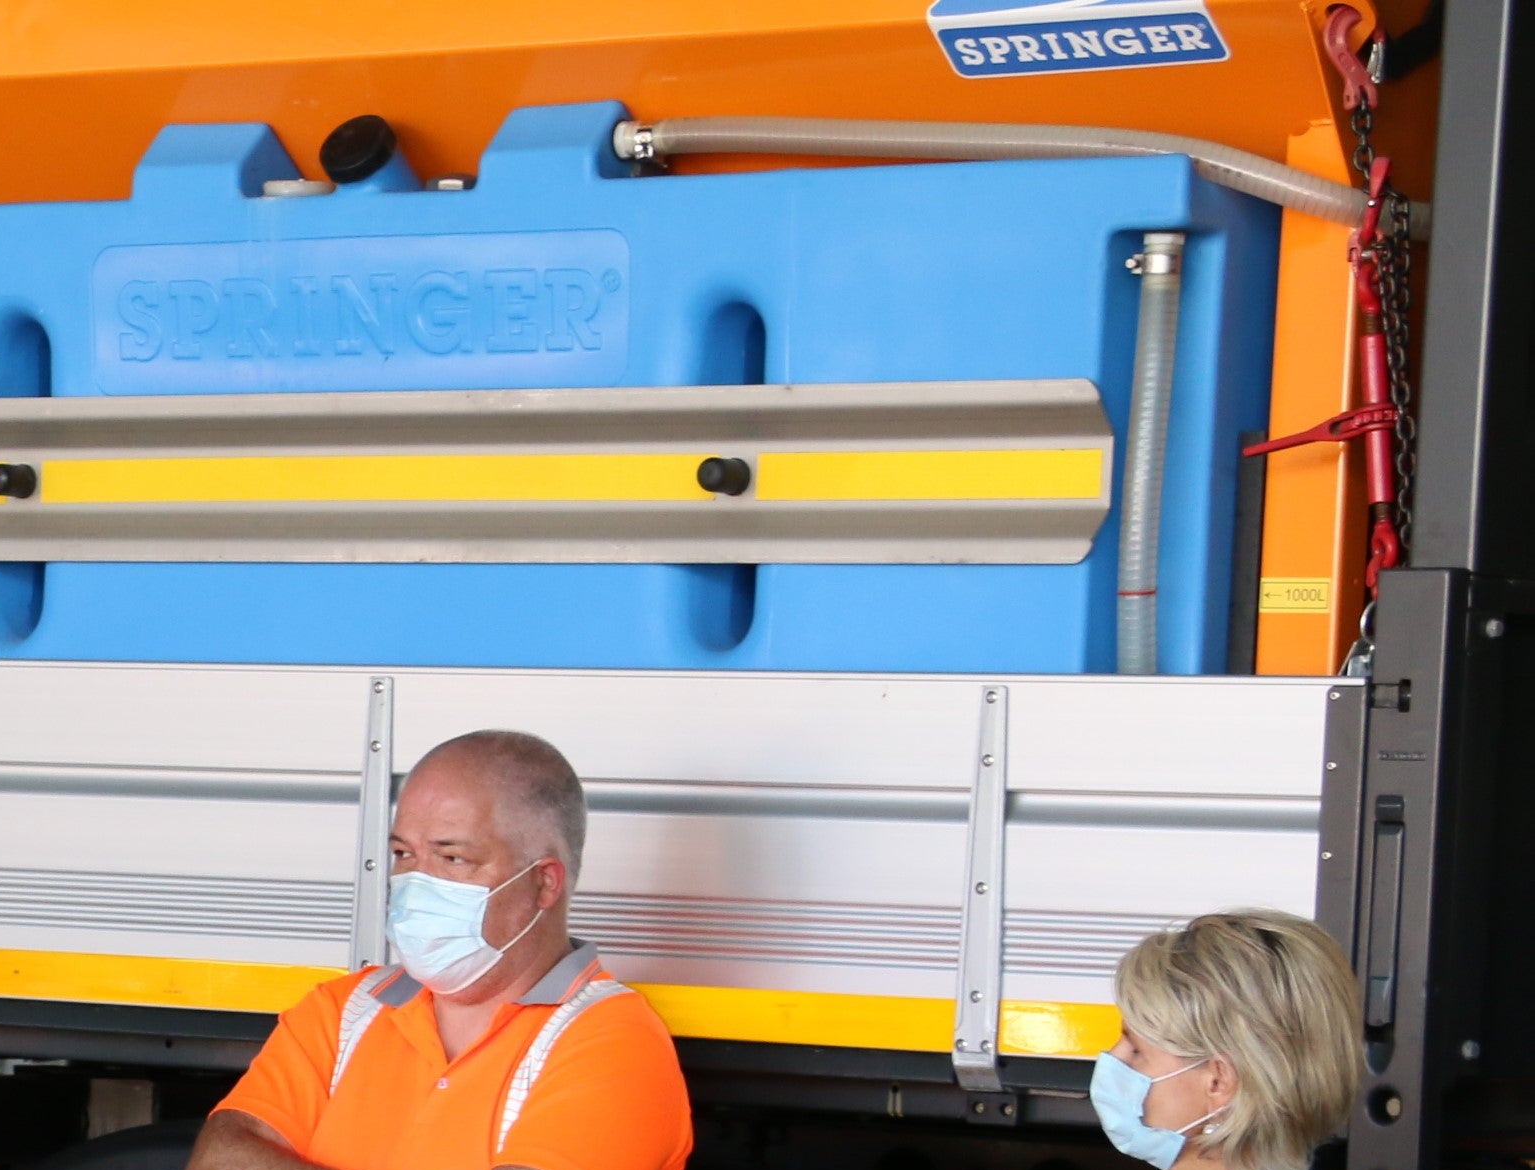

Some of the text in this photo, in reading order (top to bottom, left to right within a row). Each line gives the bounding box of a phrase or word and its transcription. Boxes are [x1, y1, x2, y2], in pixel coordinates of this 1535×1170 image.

[954, 23, 1211, 65] SPRINGER
[116, 268, 604, 362] SPRINGER
[1285, 588, 1325, 601] 1000L
